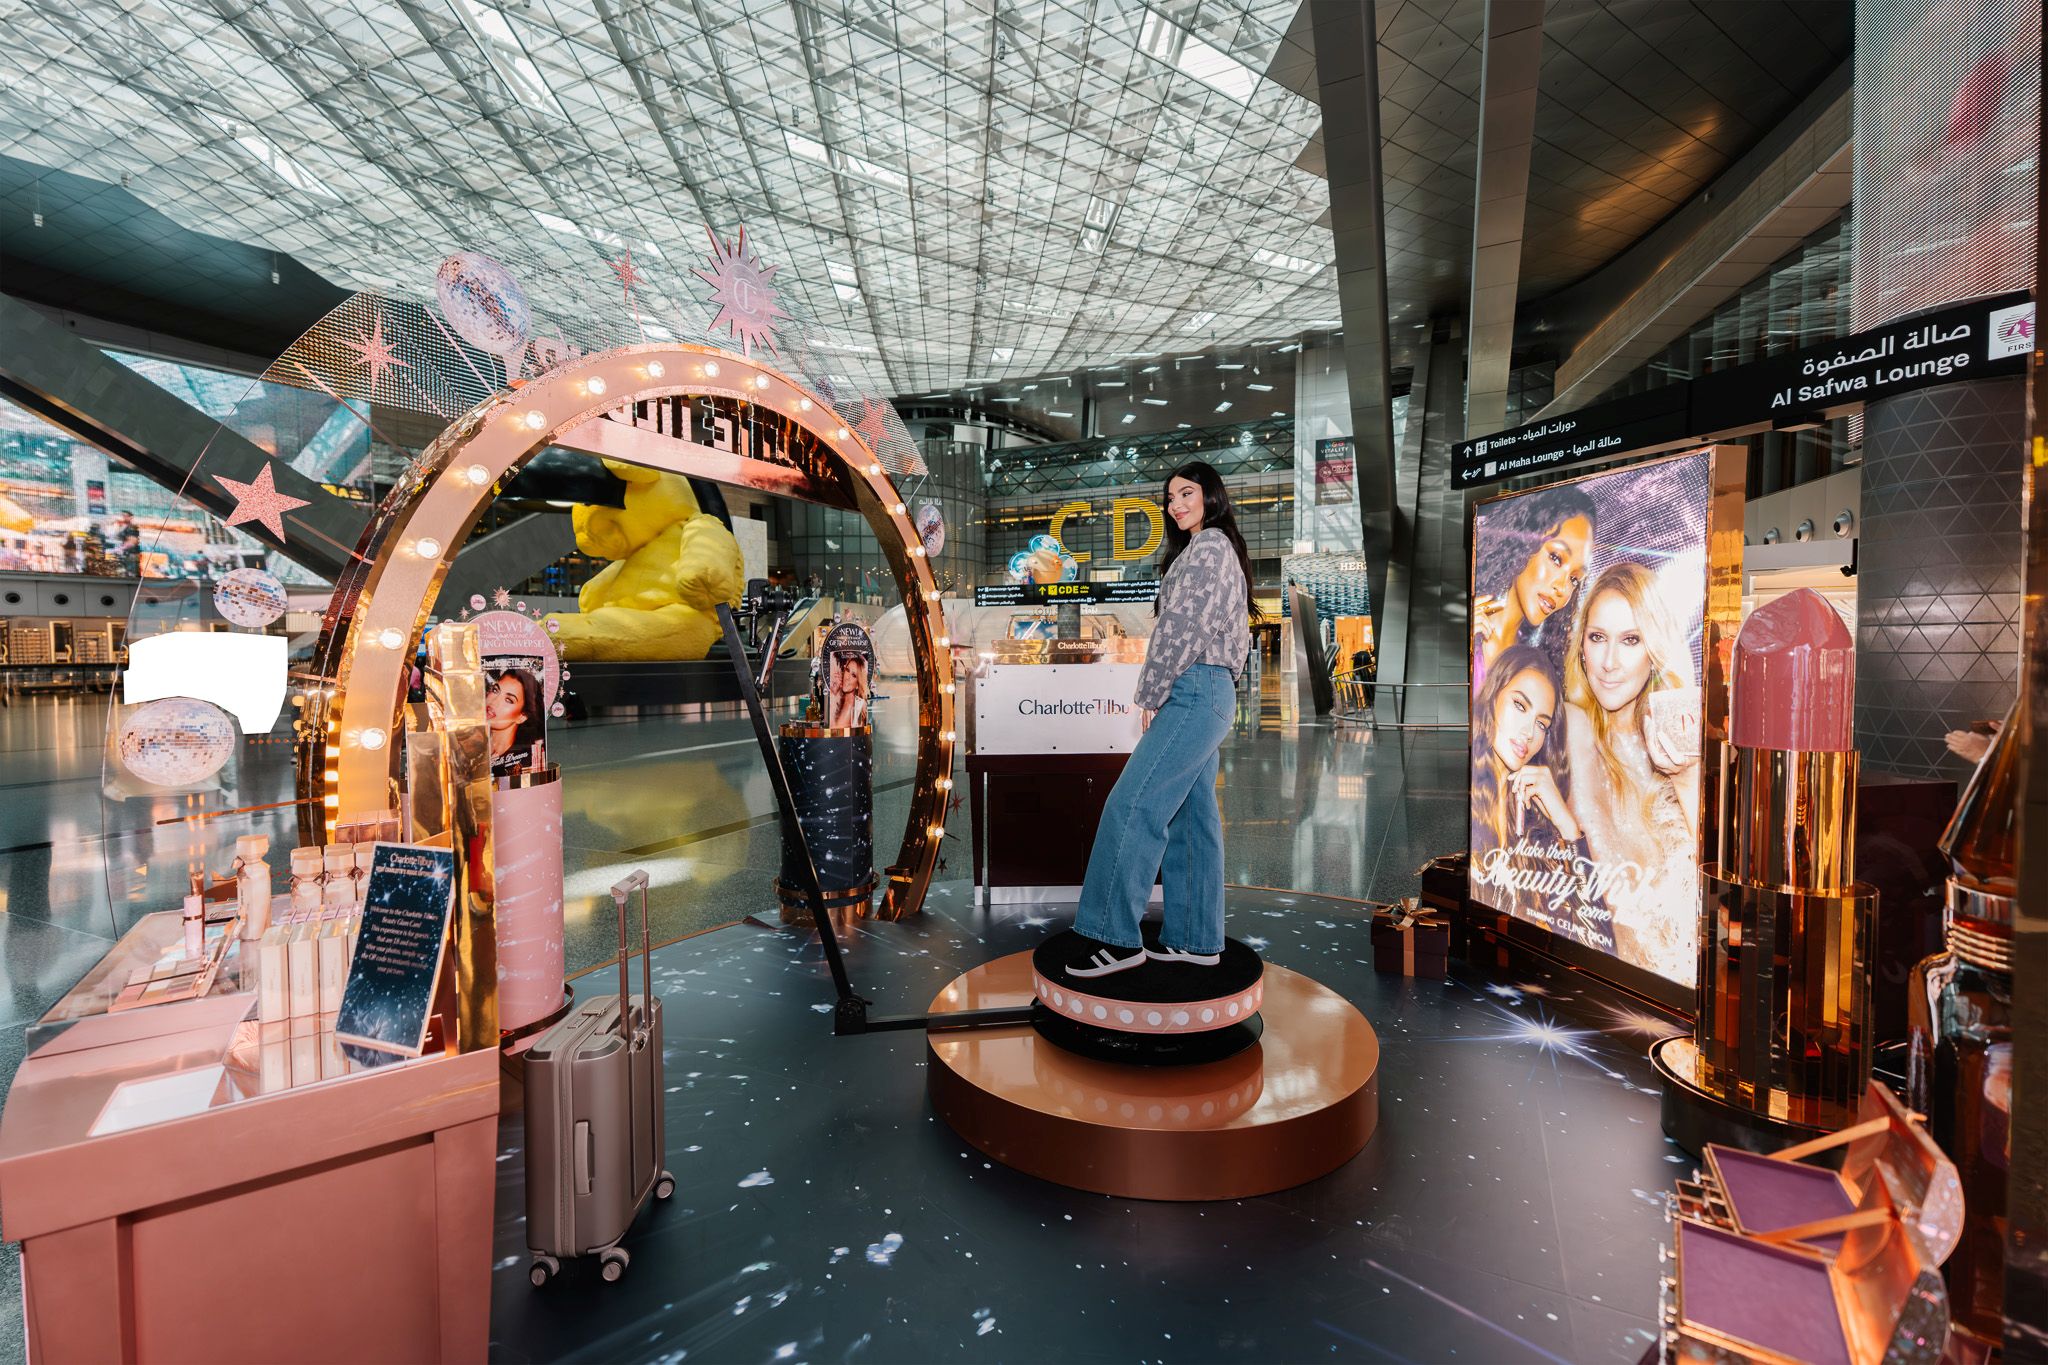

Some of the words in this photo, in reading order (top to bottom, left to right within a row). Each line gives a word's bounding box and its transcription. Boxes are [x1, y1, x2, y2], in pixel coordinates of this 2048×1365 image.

[1903, 324, 1971, 350] صالة
[1802, 335, 1894, 377] الصفوة
[1771, 387, 1791, 409] Al
[1798, 375, 1868, 402] Safwa
[1875, 352, 1970, 386] Lounge
[1522, 425, 1547, 440] المياه
[1548, 420, 1577, 435] دورات
[1490, 436, 1516, 449] Toilets
[1572, 440, 1596, 457] المها
[1597, 435, 1622, 449] صالة
[1499, 461, 1508, 472] Al
[1509, 457, 1531, 470] Maha
[1533, 450, 1564, 464] Lounge
[1058, 585, 1079, 595] CDE
[1508, 838, 1544, 858] Make
[1546, 843, 1575, 861] their
[1478, 848, 1579, 911] Beauty
[1577, 904, 1612, 922] come
[1557, 918, 1587, 938] CELINE
[1588, 927, 1613, 948] DION
